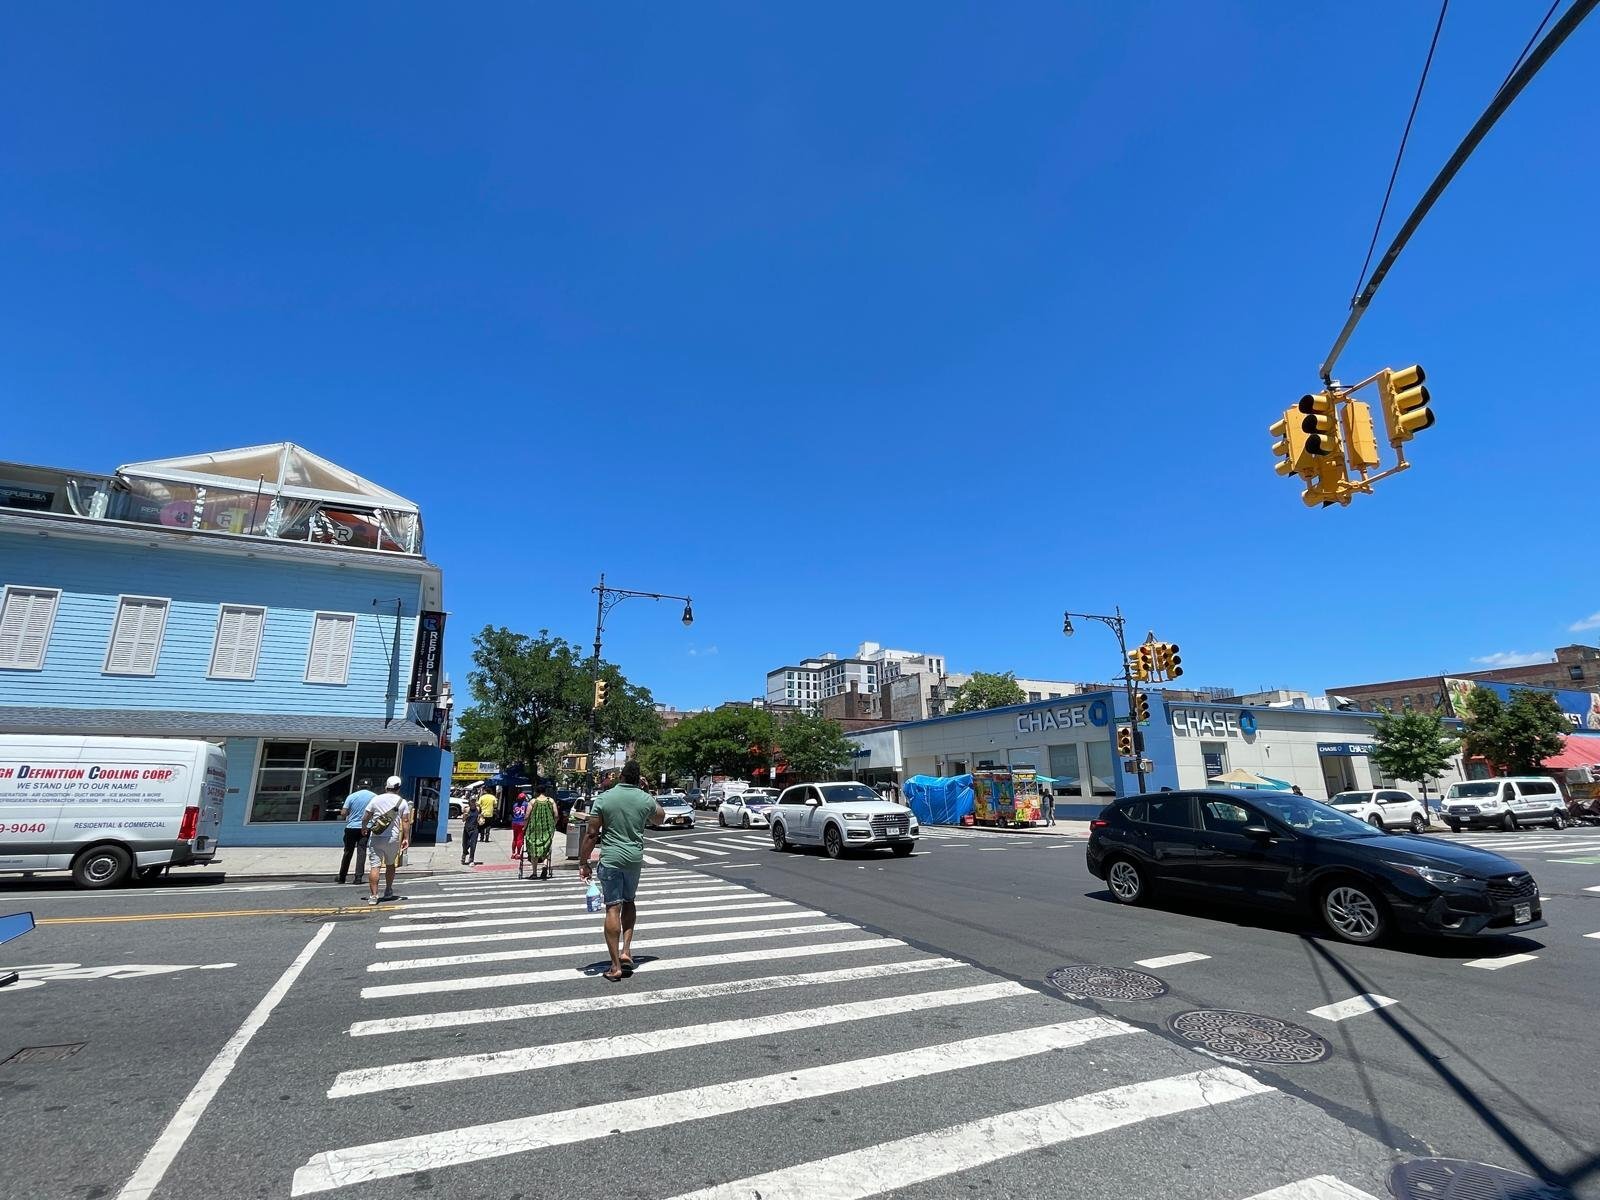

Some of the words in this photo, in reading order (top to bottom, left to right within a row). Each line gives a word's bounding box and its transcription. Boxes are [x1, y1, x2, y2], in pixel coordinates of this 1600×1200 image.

[1017, 706, 1086, 733] CHASE
[1174, 709, 1238, 732] CHASE
[17, 765, 85, 779] DEFINITION
[88, 766, 139, 780] COOLING
[142, 769, 173, 780] CORP
[17, 782, 31, 790] WE
